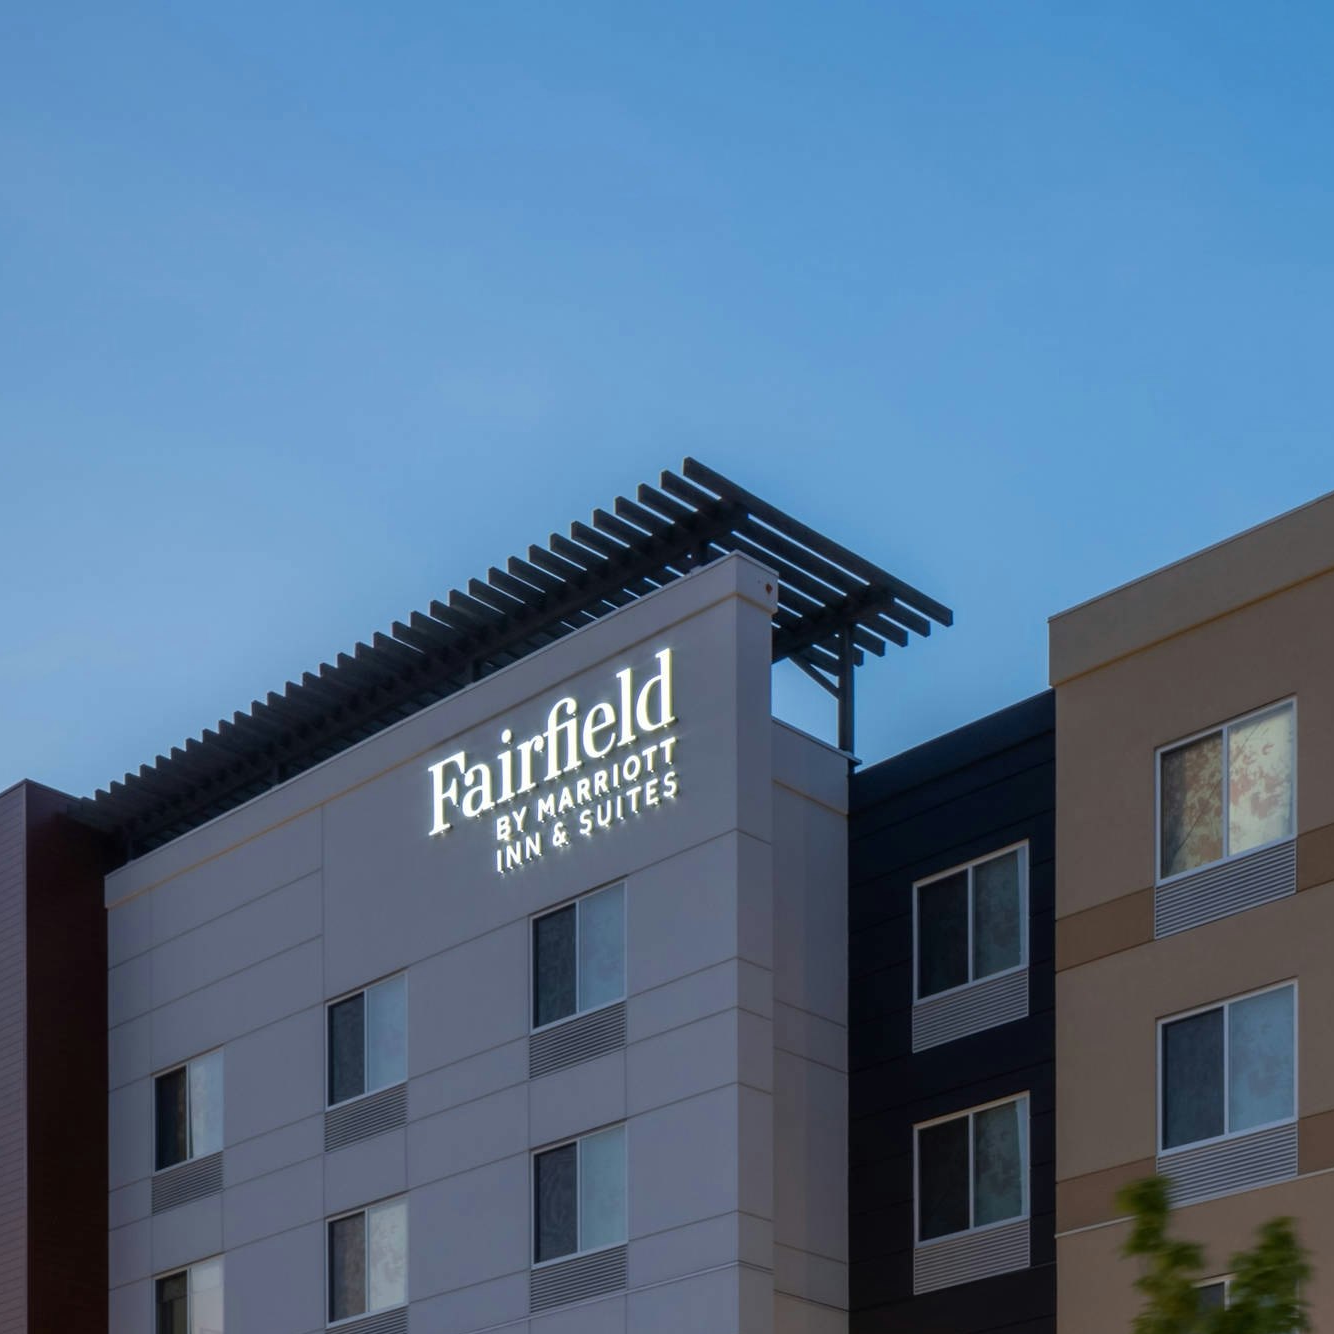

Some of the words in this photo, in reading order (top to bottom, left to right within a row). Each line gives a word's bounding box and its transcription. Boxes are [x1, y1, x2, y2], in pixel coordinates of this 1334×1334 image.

[428, 648, 677, 836] Fairfield
[497, 806, 527, 841] BY
[538, 737, 677, 822] MARRIOTT
[497, 832, 542, 873] INN
[553, 822, 568, 847] &
[579, 771, 678, 836] SUITES
